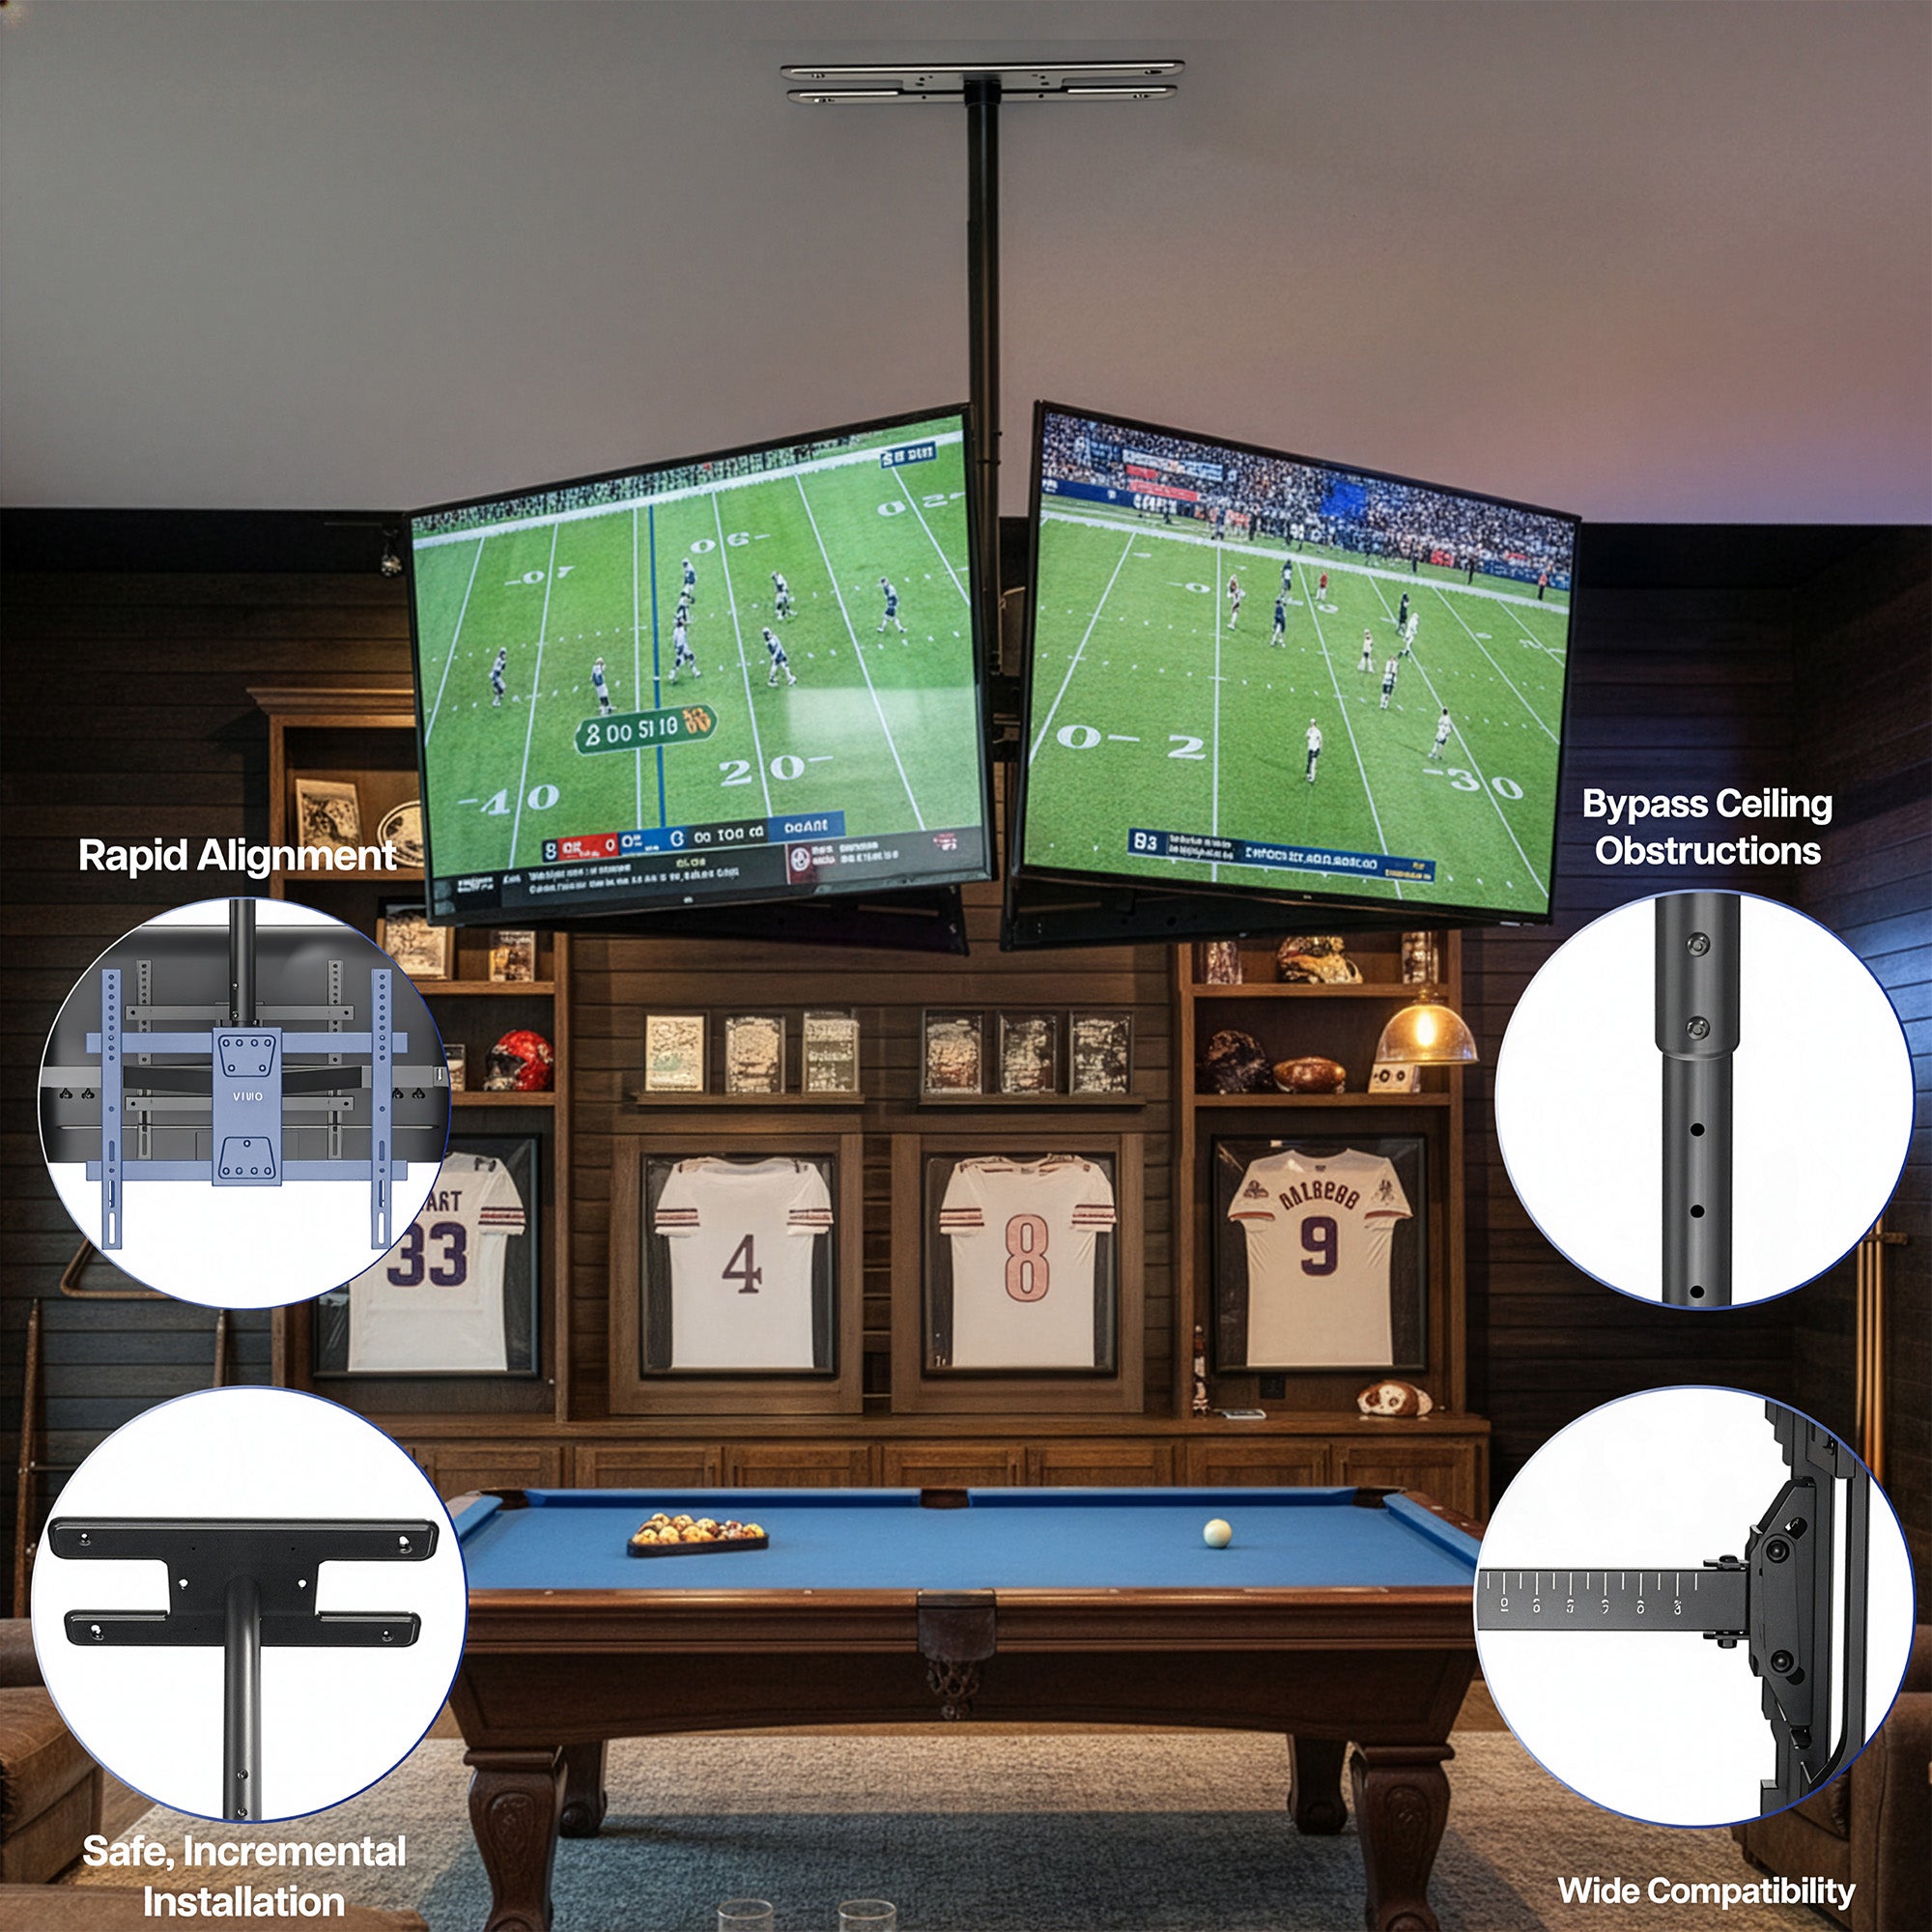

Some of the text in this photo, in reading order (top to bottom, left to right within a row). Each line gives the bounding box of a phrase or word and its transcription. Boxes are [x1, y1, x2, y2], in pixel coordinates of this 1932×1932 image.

[422, 1190, 463, 1212] ART
[722, 1234, 763, 1294] 4
[1005, 1213, 1050, 1303] 8
[1301, 1216, 1338, 1276] 9
